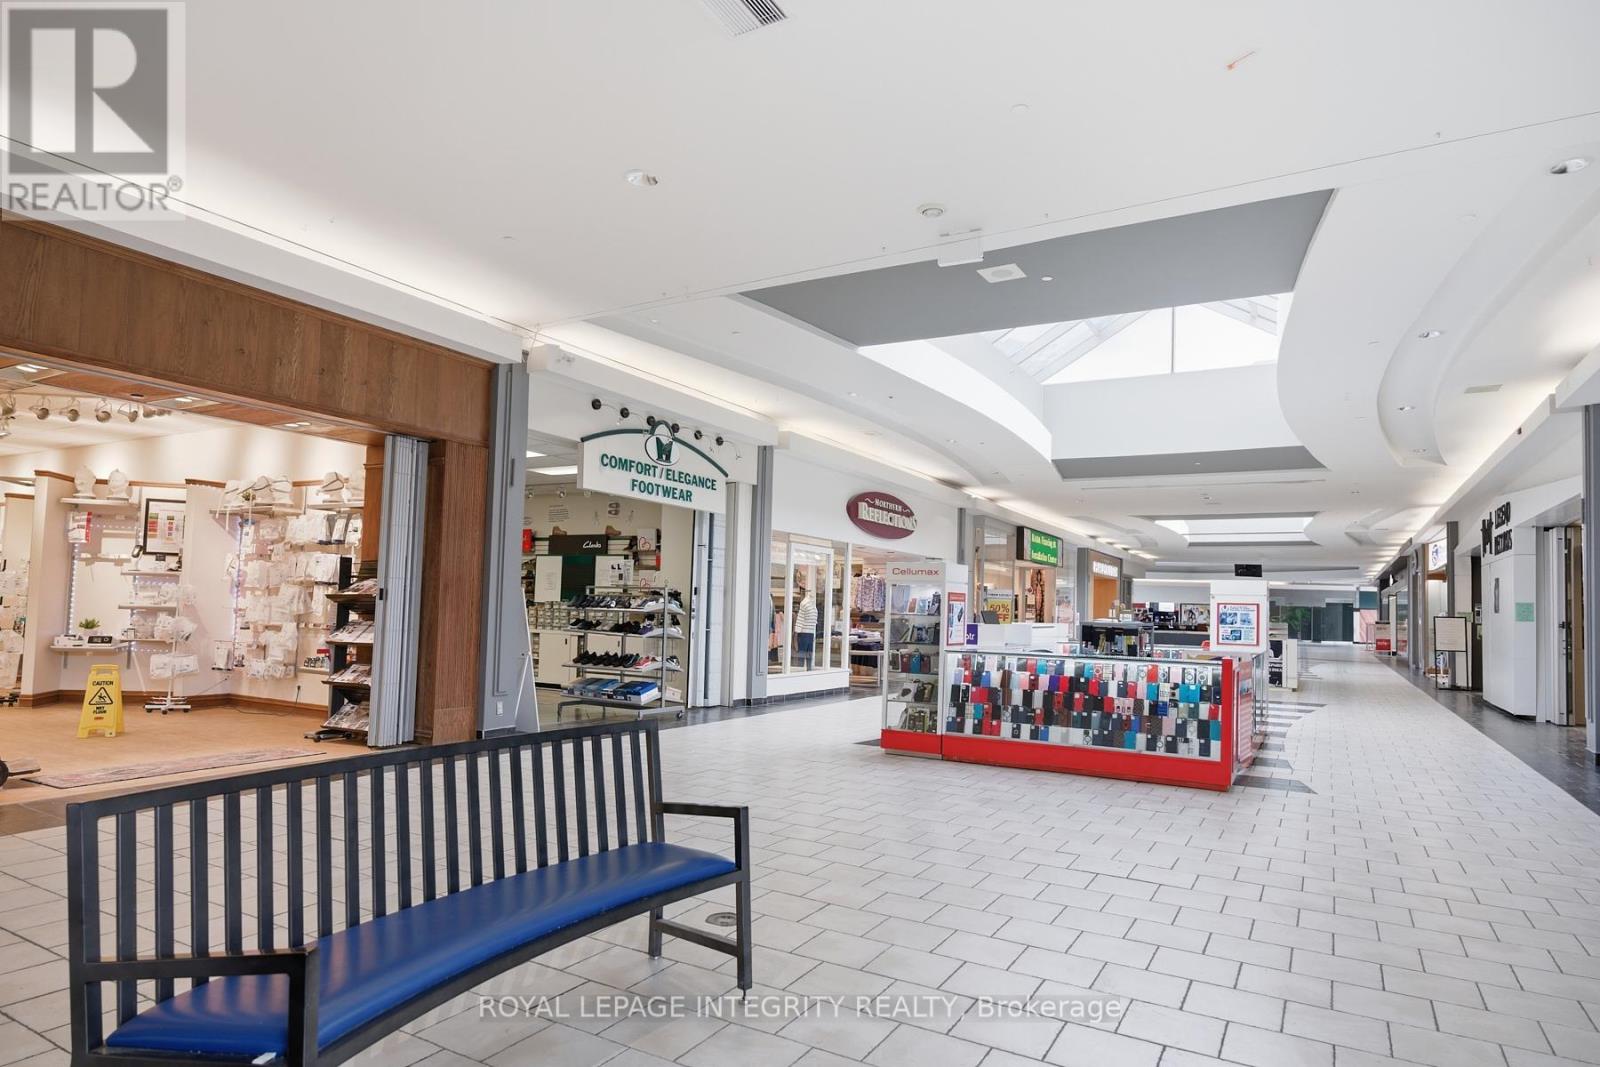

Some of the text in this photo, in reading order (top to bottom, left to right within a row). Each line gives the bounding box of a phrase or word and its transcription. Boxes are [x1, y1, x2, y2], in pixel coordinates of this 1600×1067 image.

[600, 453, 658, 478] COMFORT
[665, 469, 717, 491] ELEGANCE
[631, 479, 693, 502] FOOTWEAR
[874, 498, 903, 512] NORTHERN
[858, 502, 918, 531] REFLECTIONS
[892, 567, 939, 576] Cellumax
[990, 603, 1010, 613] 50%
